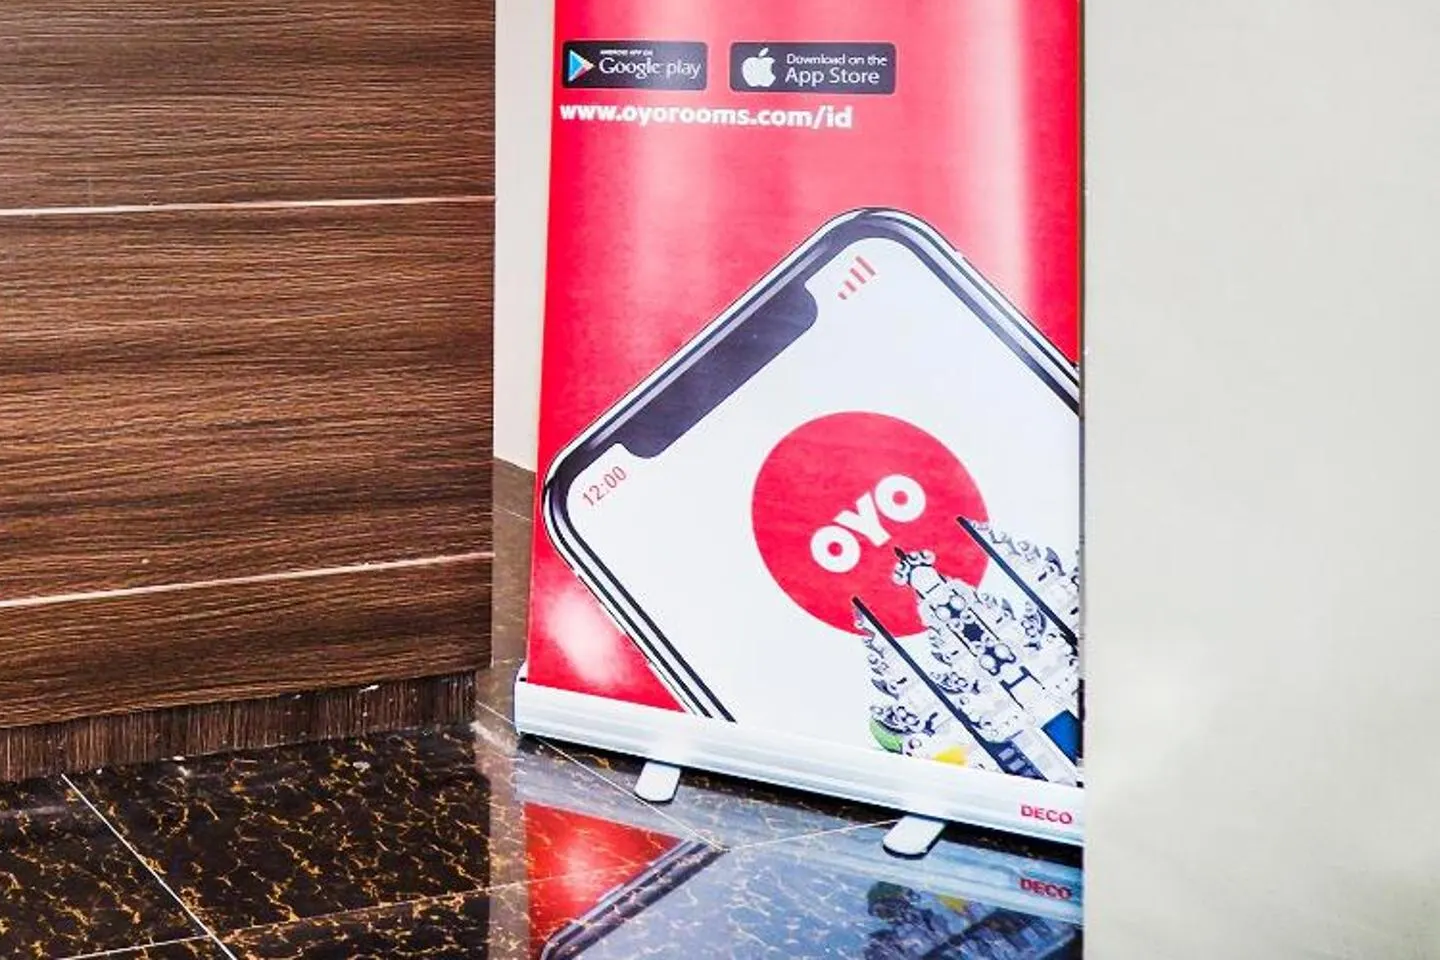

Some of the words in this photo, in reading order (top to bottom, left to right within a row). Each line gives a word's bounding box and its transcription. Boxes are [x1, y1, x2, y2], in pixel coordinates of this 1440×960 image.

[599, 57, 660, 80] Google
[665, 59, 701, 80] play
[786, 53, 845, 65] Download
[848, 55, 865, 65] on
[867, 53, 888, 66] the
[784, 67, 824, 86] App
[829, 66, 880, 85] Store
[560, 104, 853, 129] www.oyorooms.com/id
[581, 465, 628, 508] 12:00
[810, 474, 926, 572] OYO
[1020, 805, 1073, 825] DECO
